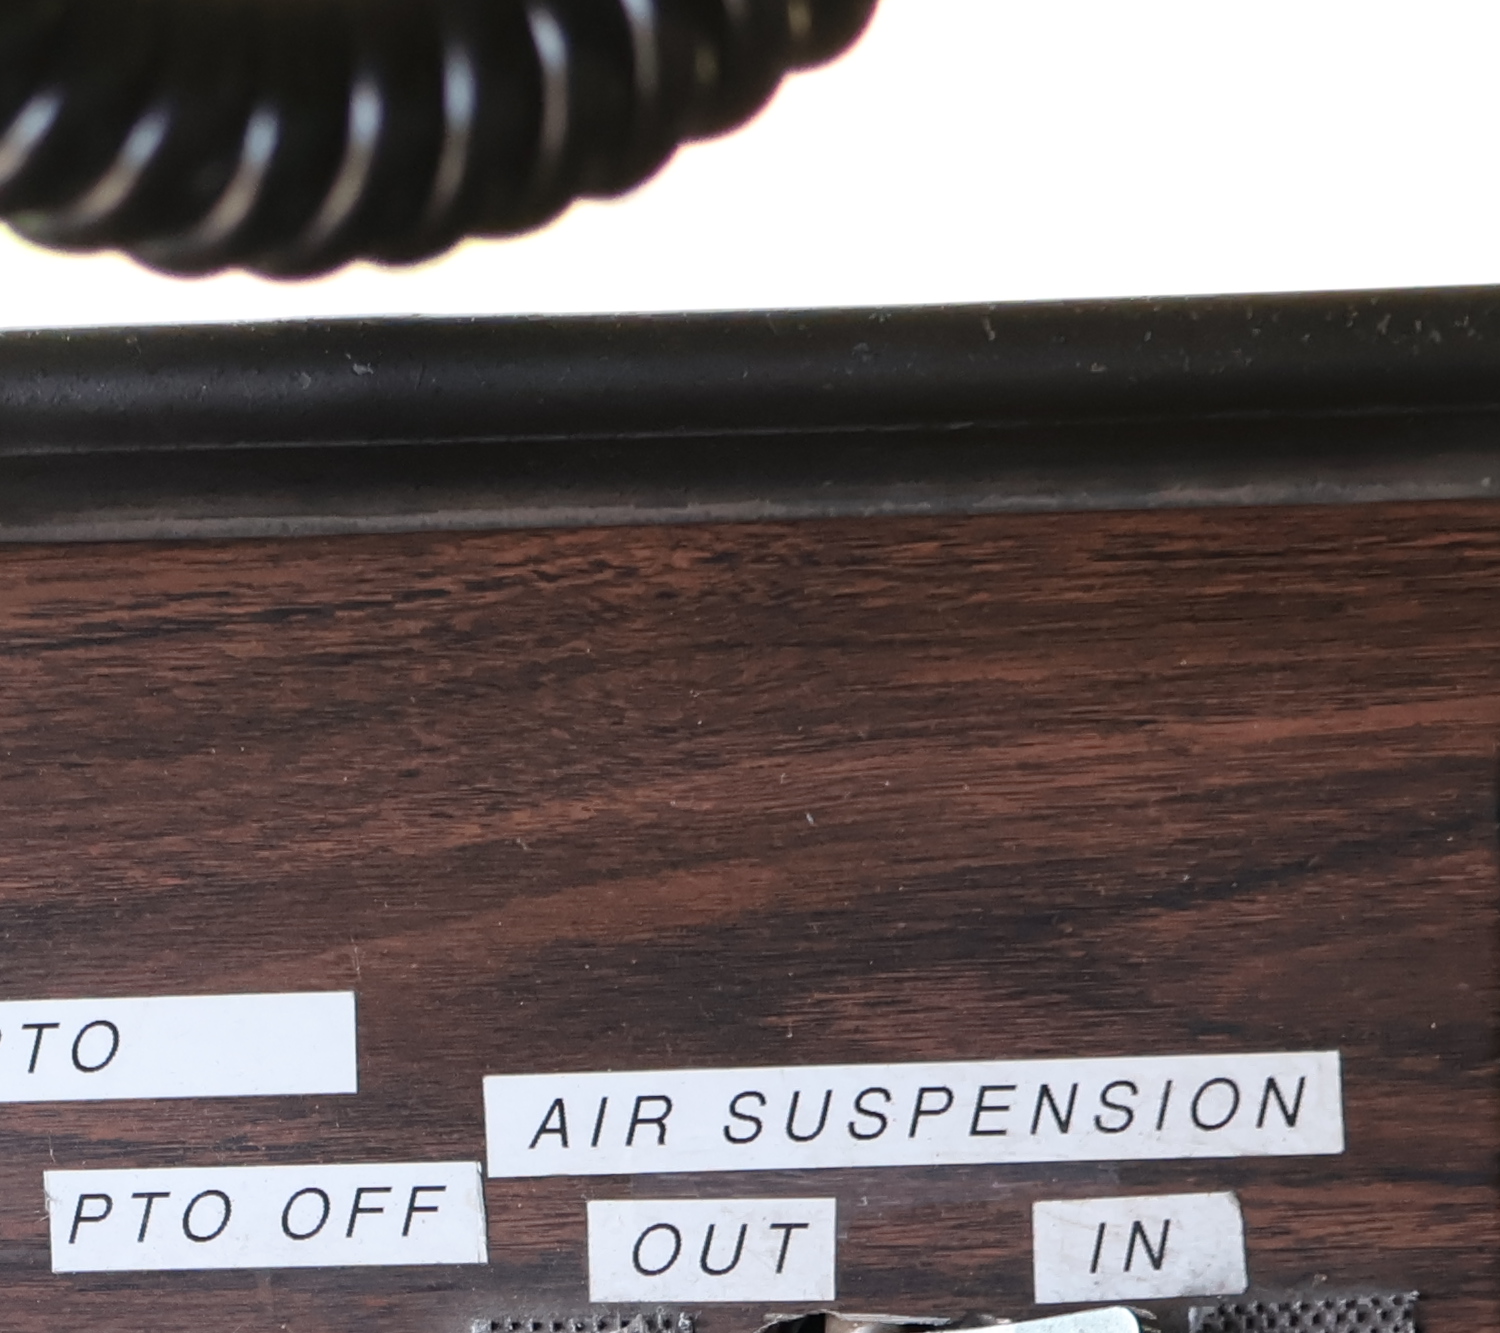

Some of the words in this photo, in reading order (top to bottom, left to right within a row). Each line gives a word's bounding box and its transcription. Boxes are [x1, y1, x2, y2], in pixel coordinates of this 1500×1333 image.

[530, 1094, 673, 1149] AIR
[722, 1077, 1307, 1143] SUSPENSION
[68, 1189, 231, 1243] PTO
[280, 1185, 445, 1240] OFF
[632, 1223, 809, 1276] OUT
[1089, 1220, 1171, 1274] IN
